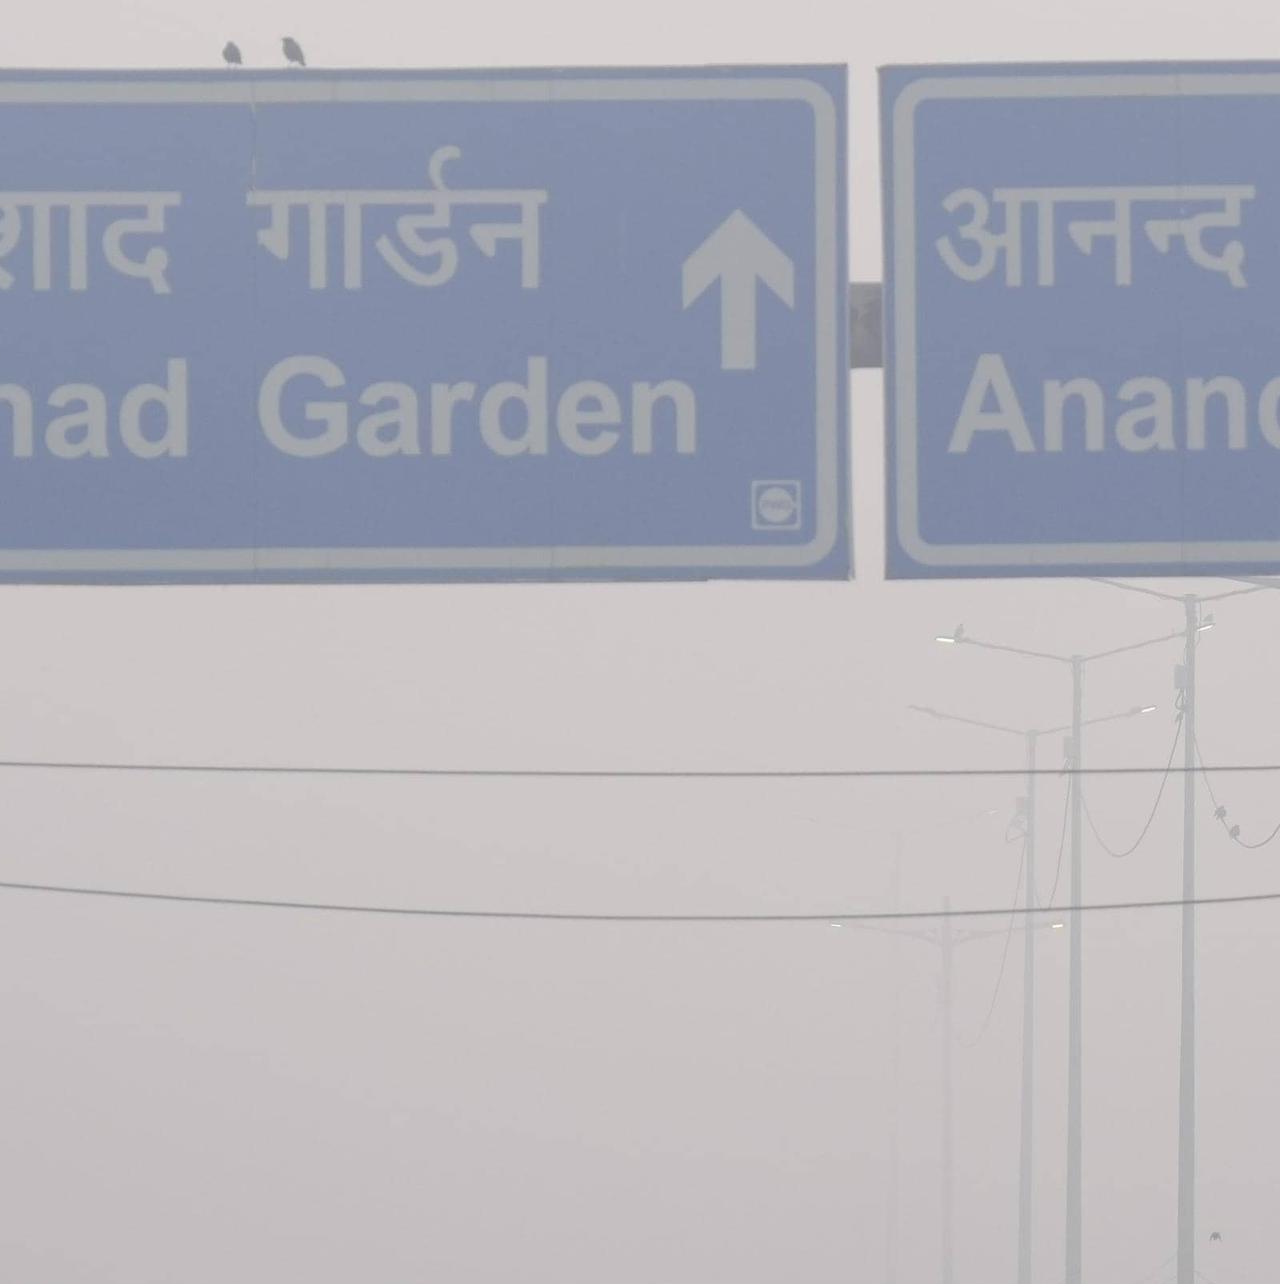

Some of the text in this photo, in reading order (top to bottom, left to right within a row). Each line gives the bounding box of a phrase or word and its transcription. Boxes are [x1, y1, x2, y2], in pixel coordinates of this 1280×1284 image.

[246, 145, 548, 290] गार्डन
[936, 185, 1255, 288] आनन्द
[258, 354, 697, 457] Garden
